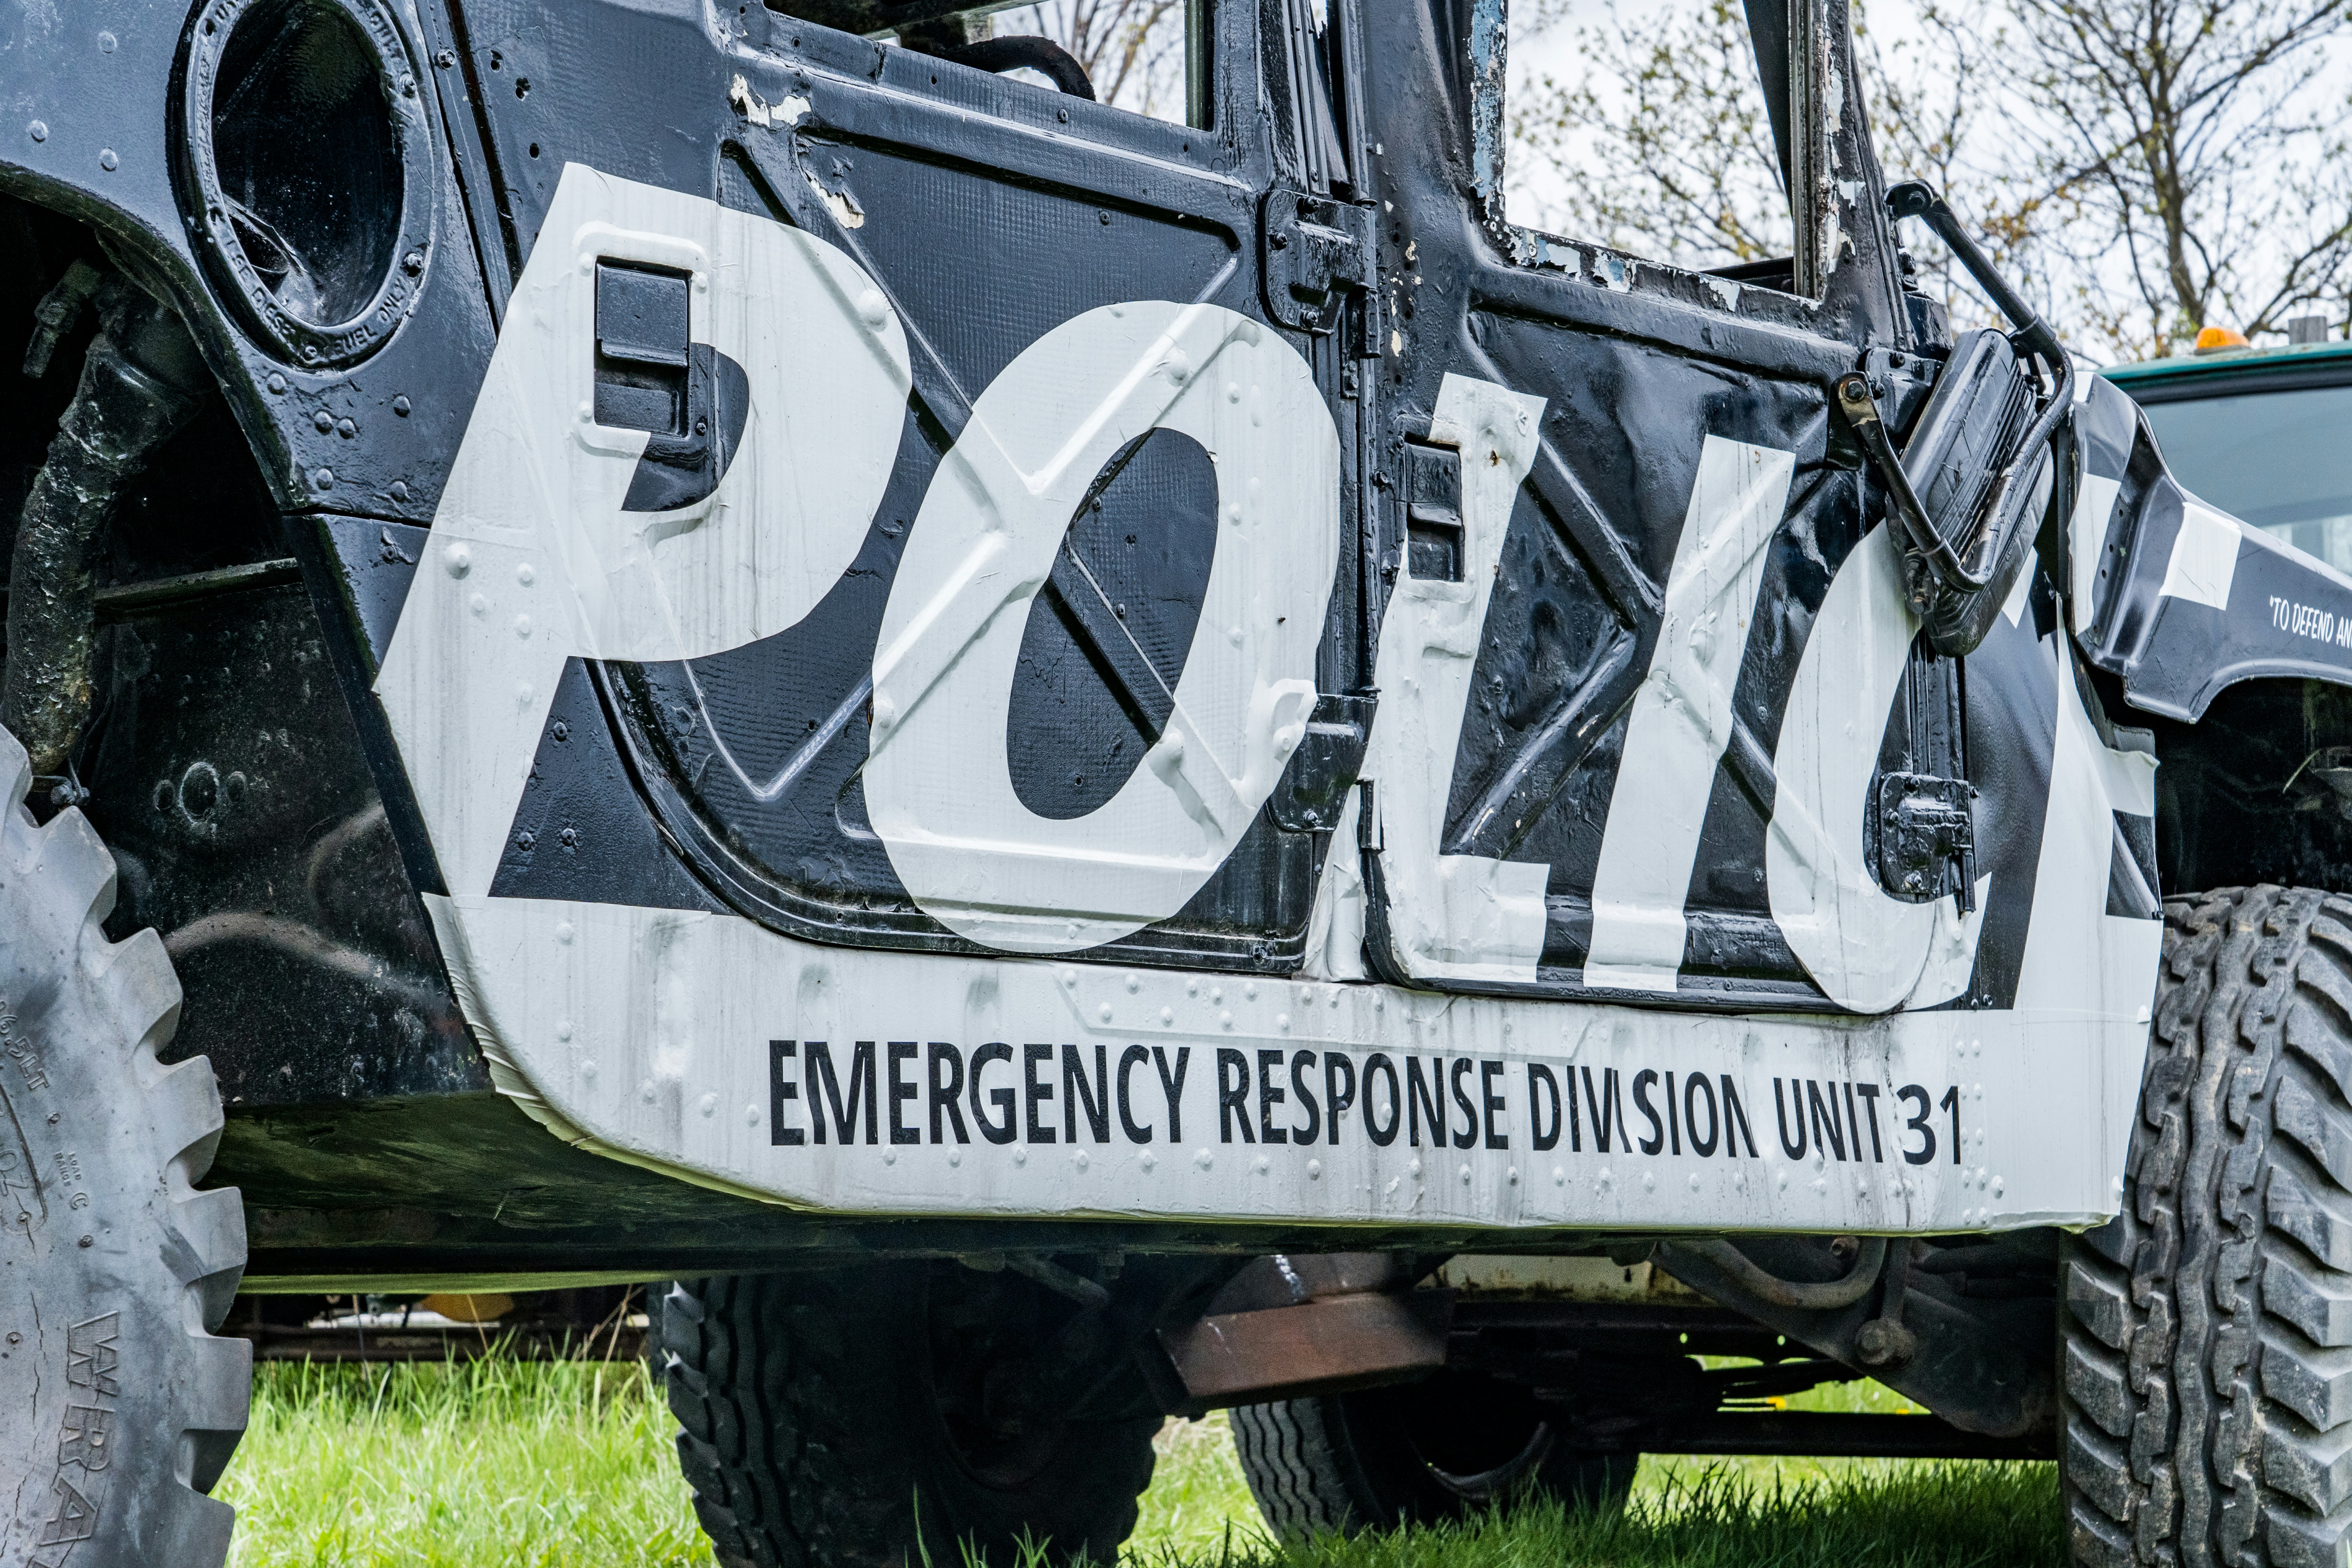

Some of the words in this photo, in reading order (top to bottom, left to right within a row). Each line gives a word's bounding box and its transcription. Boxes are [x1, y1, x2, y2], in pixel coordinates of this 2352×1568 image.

[372, 161, 2242, 1015] POLICE
[2292, 603, 2334, 643] DEFEND
[769, 1040, 1191, 1146] EMERGENCY
[1216, 1047, 1508, 1150] RESPONSE
[1527, 1062, 1759, 1158] DIVISION
[1773, 1077, 1884, 1163] UNIT
[1895, 1083, 1961, 1165] 31
